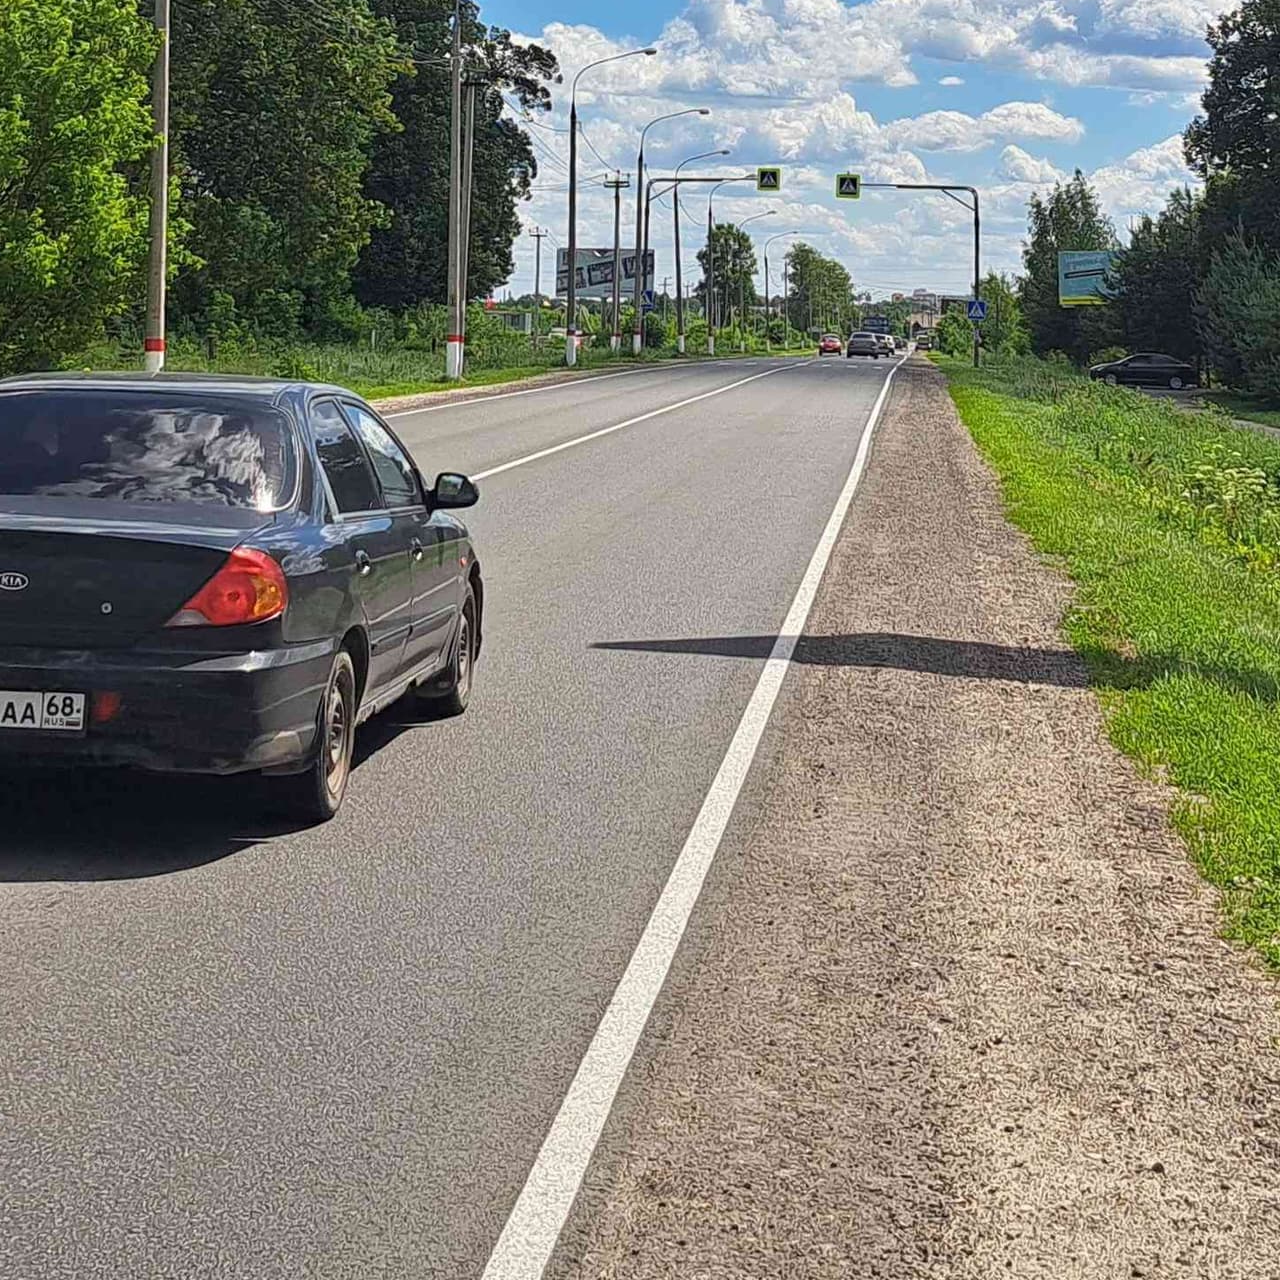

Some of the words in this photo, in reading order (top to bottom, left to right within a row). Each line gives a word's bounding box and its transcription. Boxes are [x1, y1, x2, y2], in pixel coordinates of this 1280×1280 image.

[0, 575, 23, 587] KIA
[45, 695, 75, 717] 68
[43, 717, 66, 727] RUS
